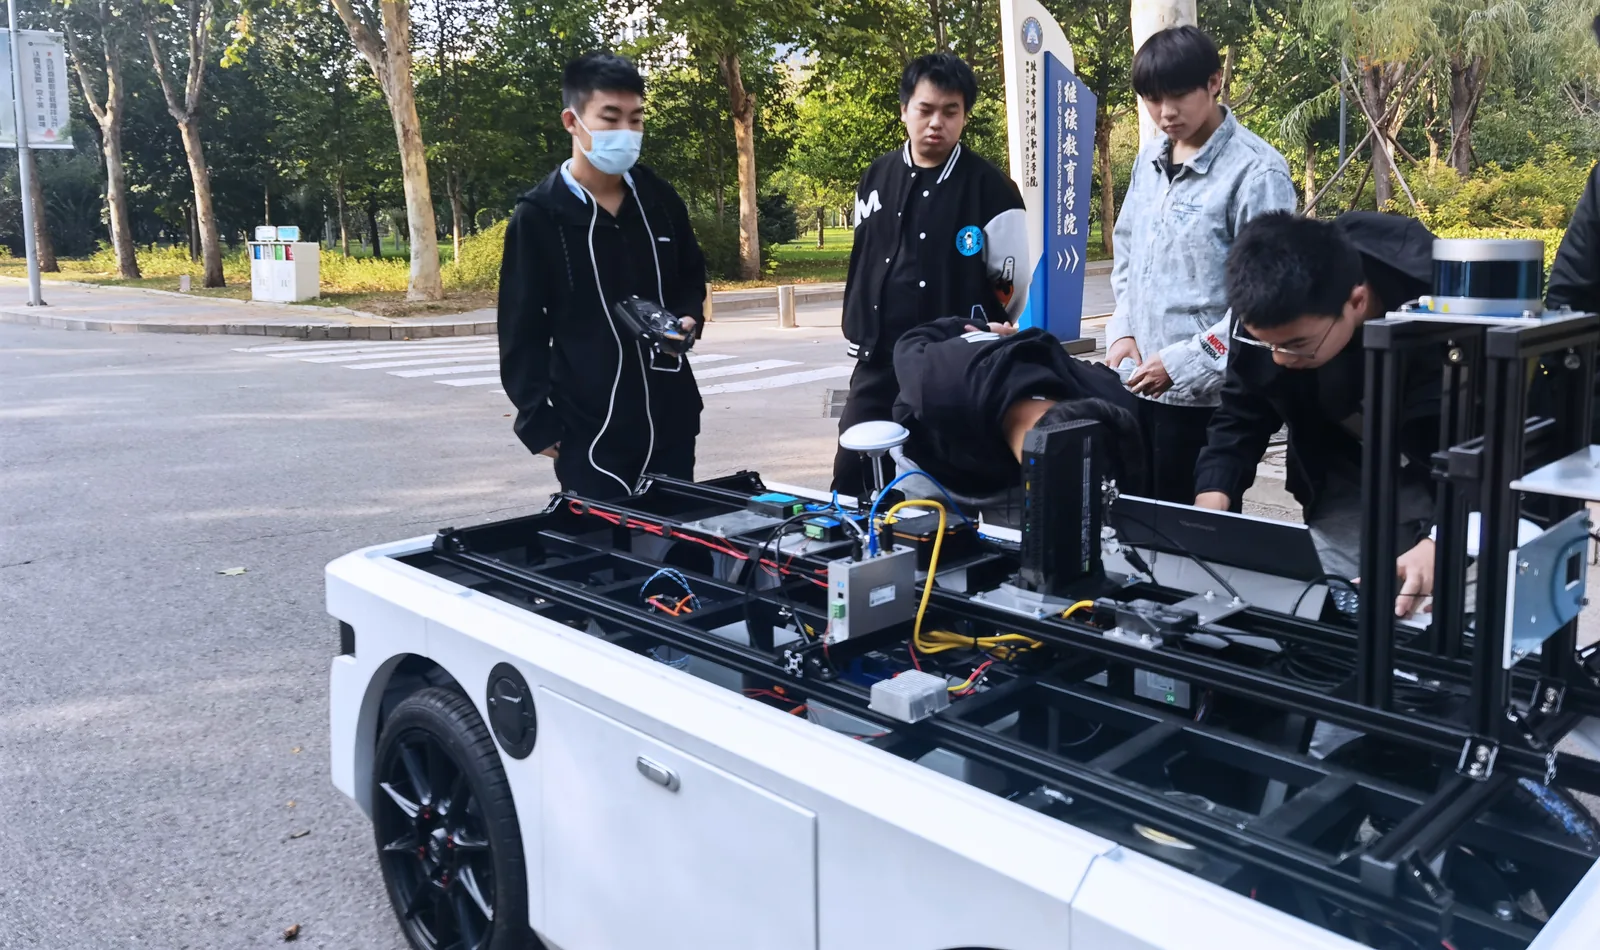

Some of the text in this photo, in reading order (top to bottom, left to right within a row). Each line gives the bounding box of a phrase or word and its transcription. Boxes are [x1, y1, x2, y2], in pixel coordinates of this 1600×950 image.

[1063, 81, 1079, 235] 继续教育学院
[855, 189, 882, 229] M
